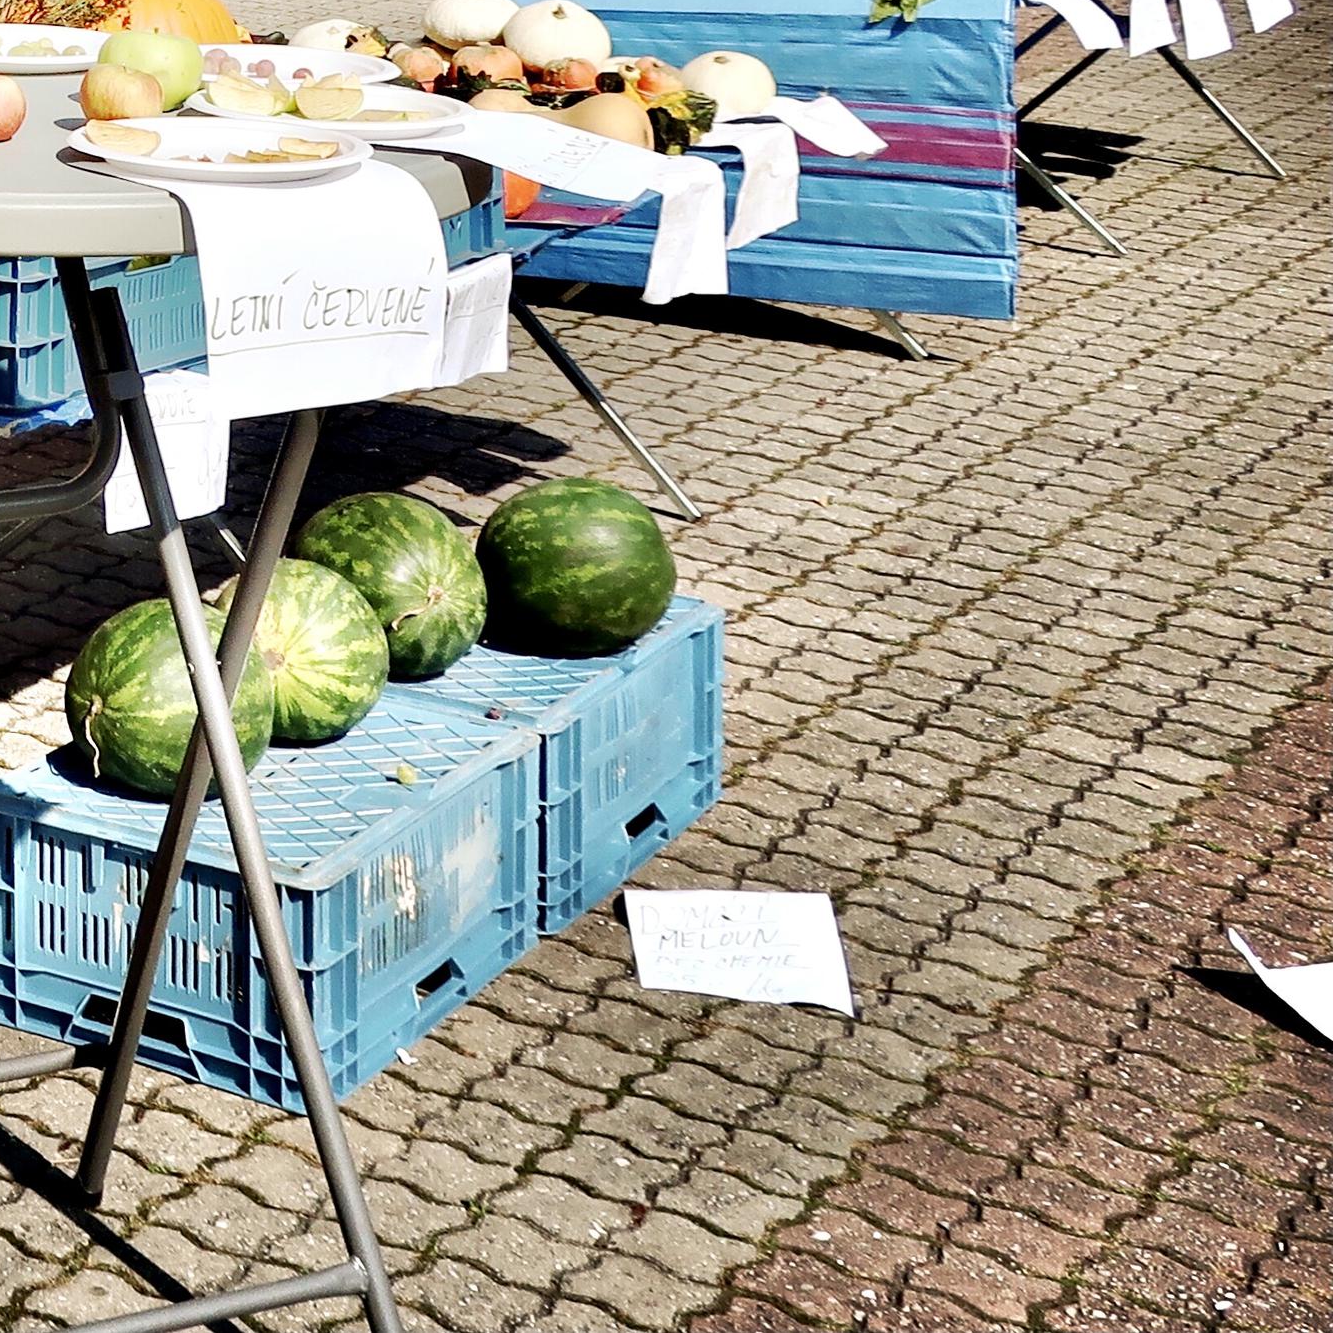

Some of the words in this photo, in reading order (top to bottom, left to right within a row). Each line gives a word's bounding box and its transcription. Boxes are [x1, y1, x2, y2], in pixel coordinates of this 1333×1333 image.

[209, 270, 300, 342] LETNÍ
[302, 257, 436, 328] ČERVENÉ
[658, 928, 777, 951] MELOUN
